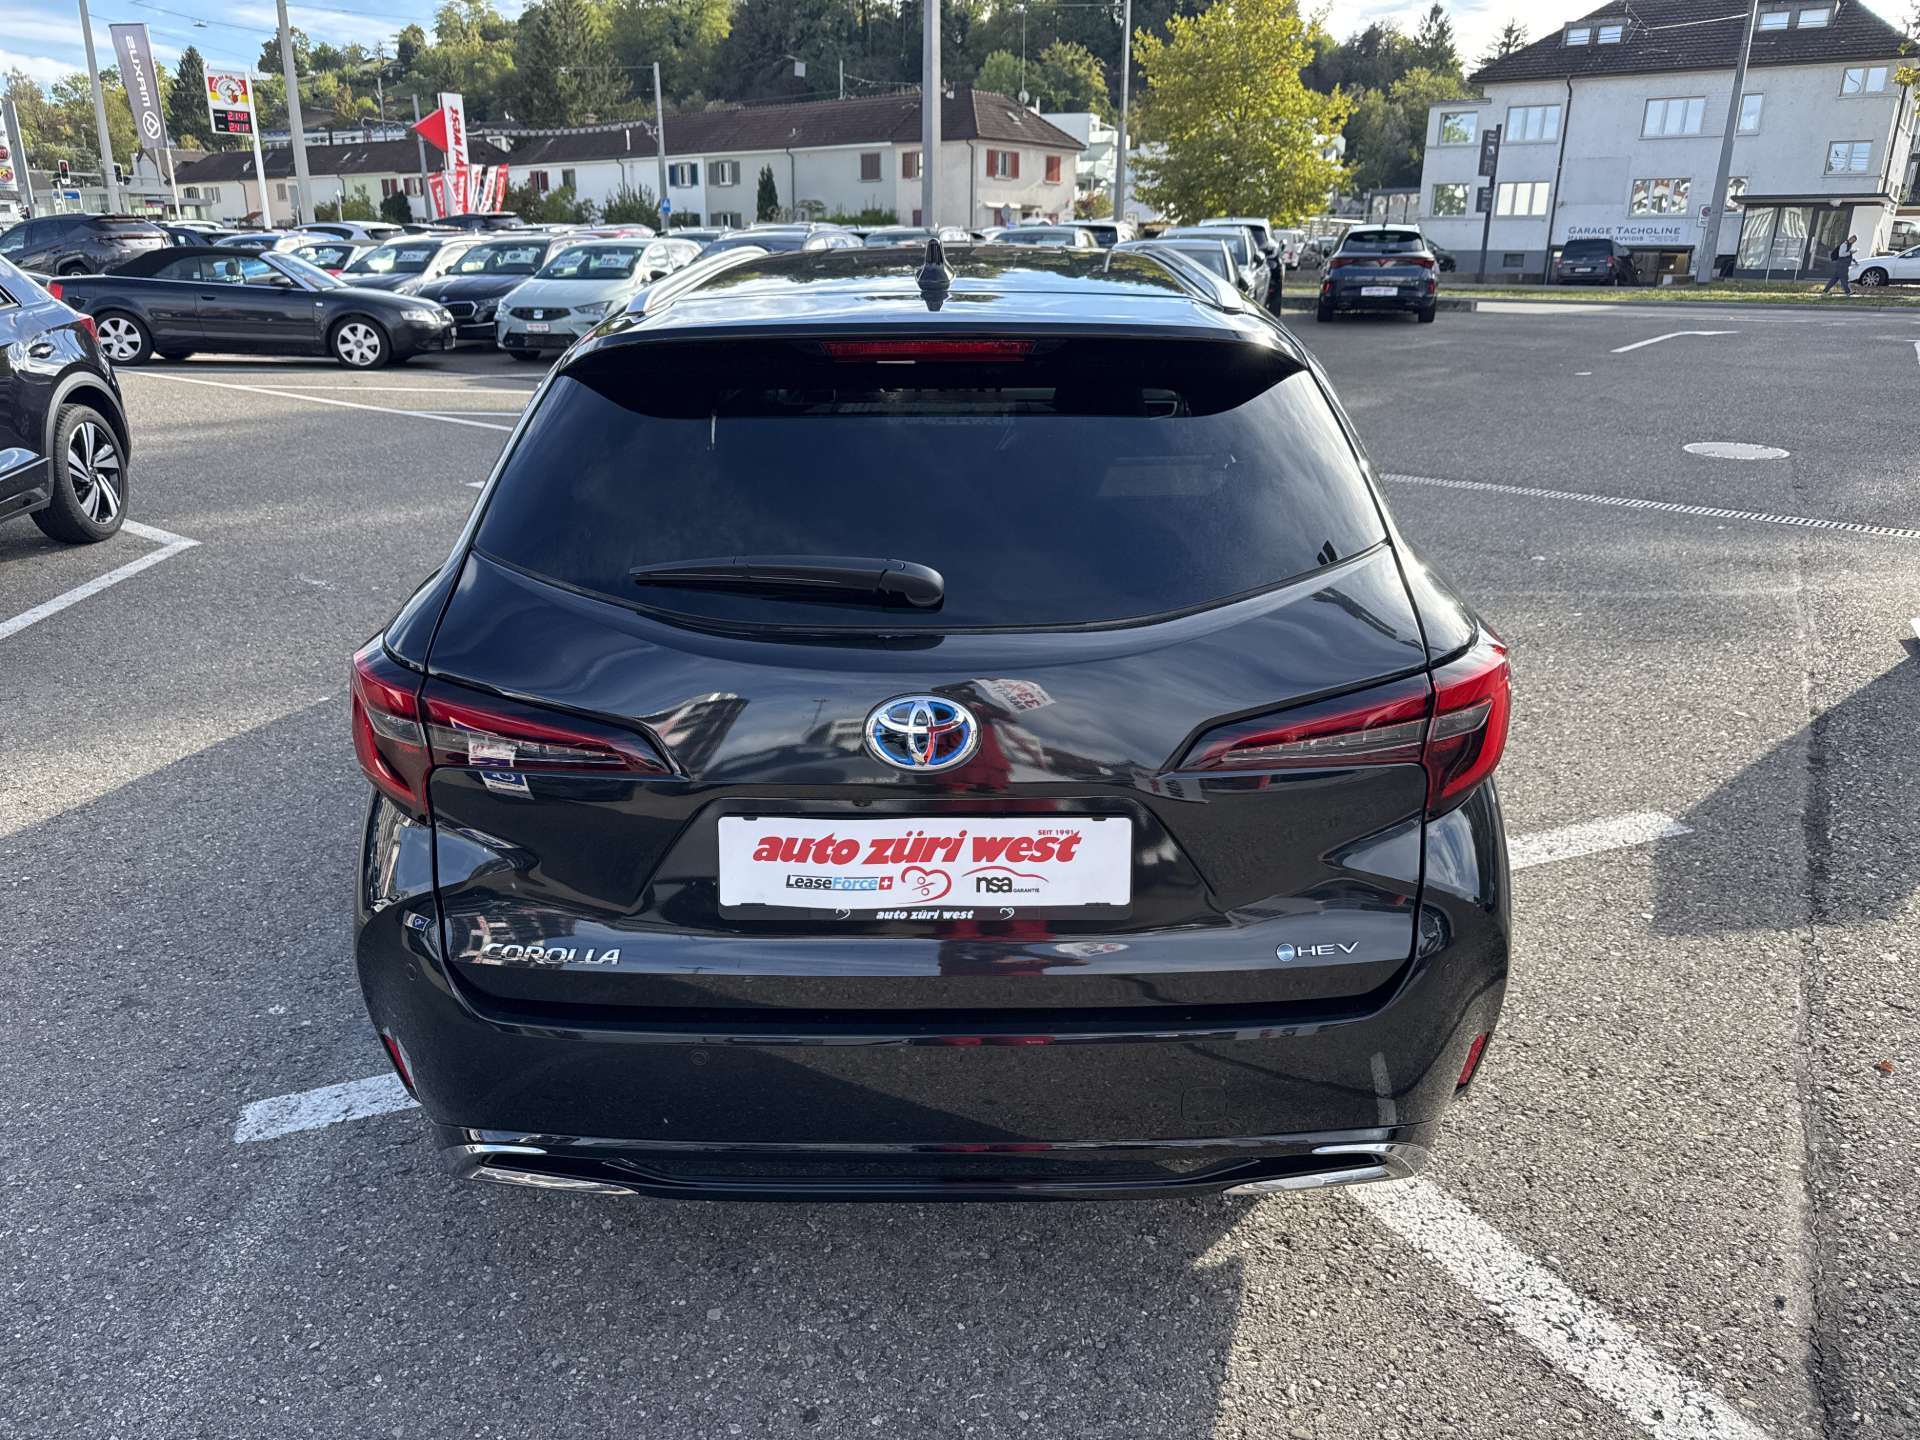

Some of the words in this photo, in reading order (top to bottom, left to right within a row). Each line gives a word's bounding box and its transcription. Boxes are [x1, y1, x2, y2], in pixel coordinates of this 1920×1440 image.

[450, 106, 463, 146] west
[1568, 226, 1612, 235] GARAGE
[1615, 226, 1681, 235] TACHOLINE
[752, 832, 860, 866] auto
[861, 830, 967, 865] züri
[972, 831, 1082, 863] west
[786, 874, 878, 891] LeaseForce
[976, 876, 1012, 893] nsa
[876, 911, 907, 920] auto
[910, 909, 939, 920] züri
[942, 910, 974, 920] west
[484, 943, 621, 965] COROLLA
[1297, 941, 1359, 957] HEV
